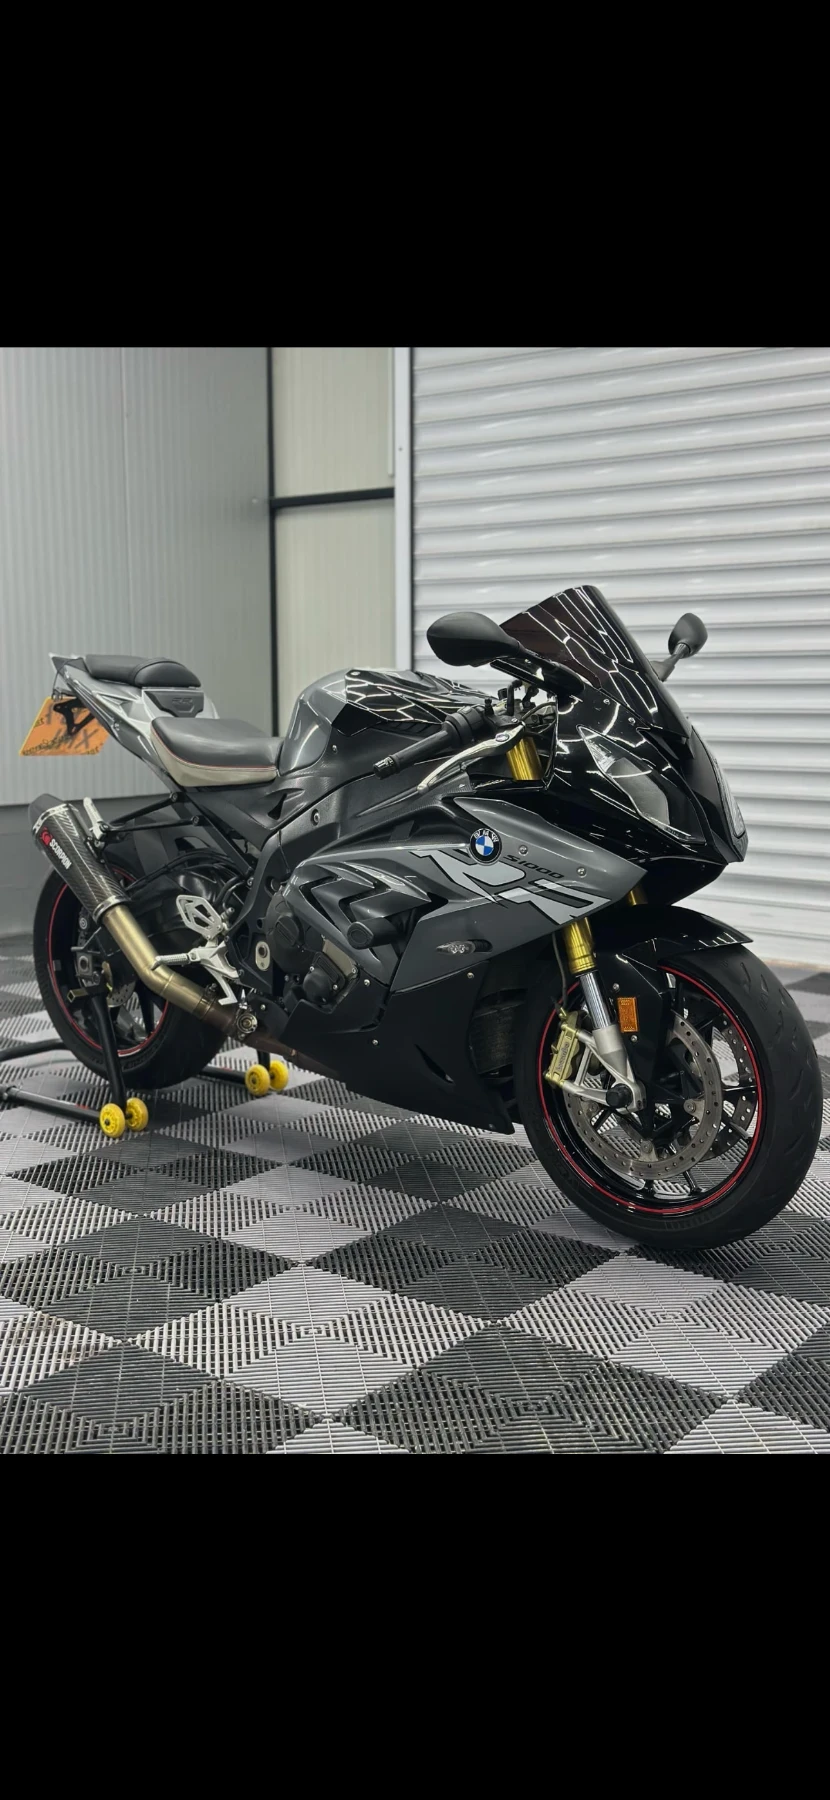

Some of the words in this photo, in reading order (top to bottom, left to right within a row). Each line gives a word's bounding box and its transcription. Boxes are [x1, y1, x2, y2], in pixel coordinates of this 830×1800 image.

[473, 828, 500, 843] BMW
[49, 838, 72, 870] SCORPION
[503, 854, 565, 879] S1000
